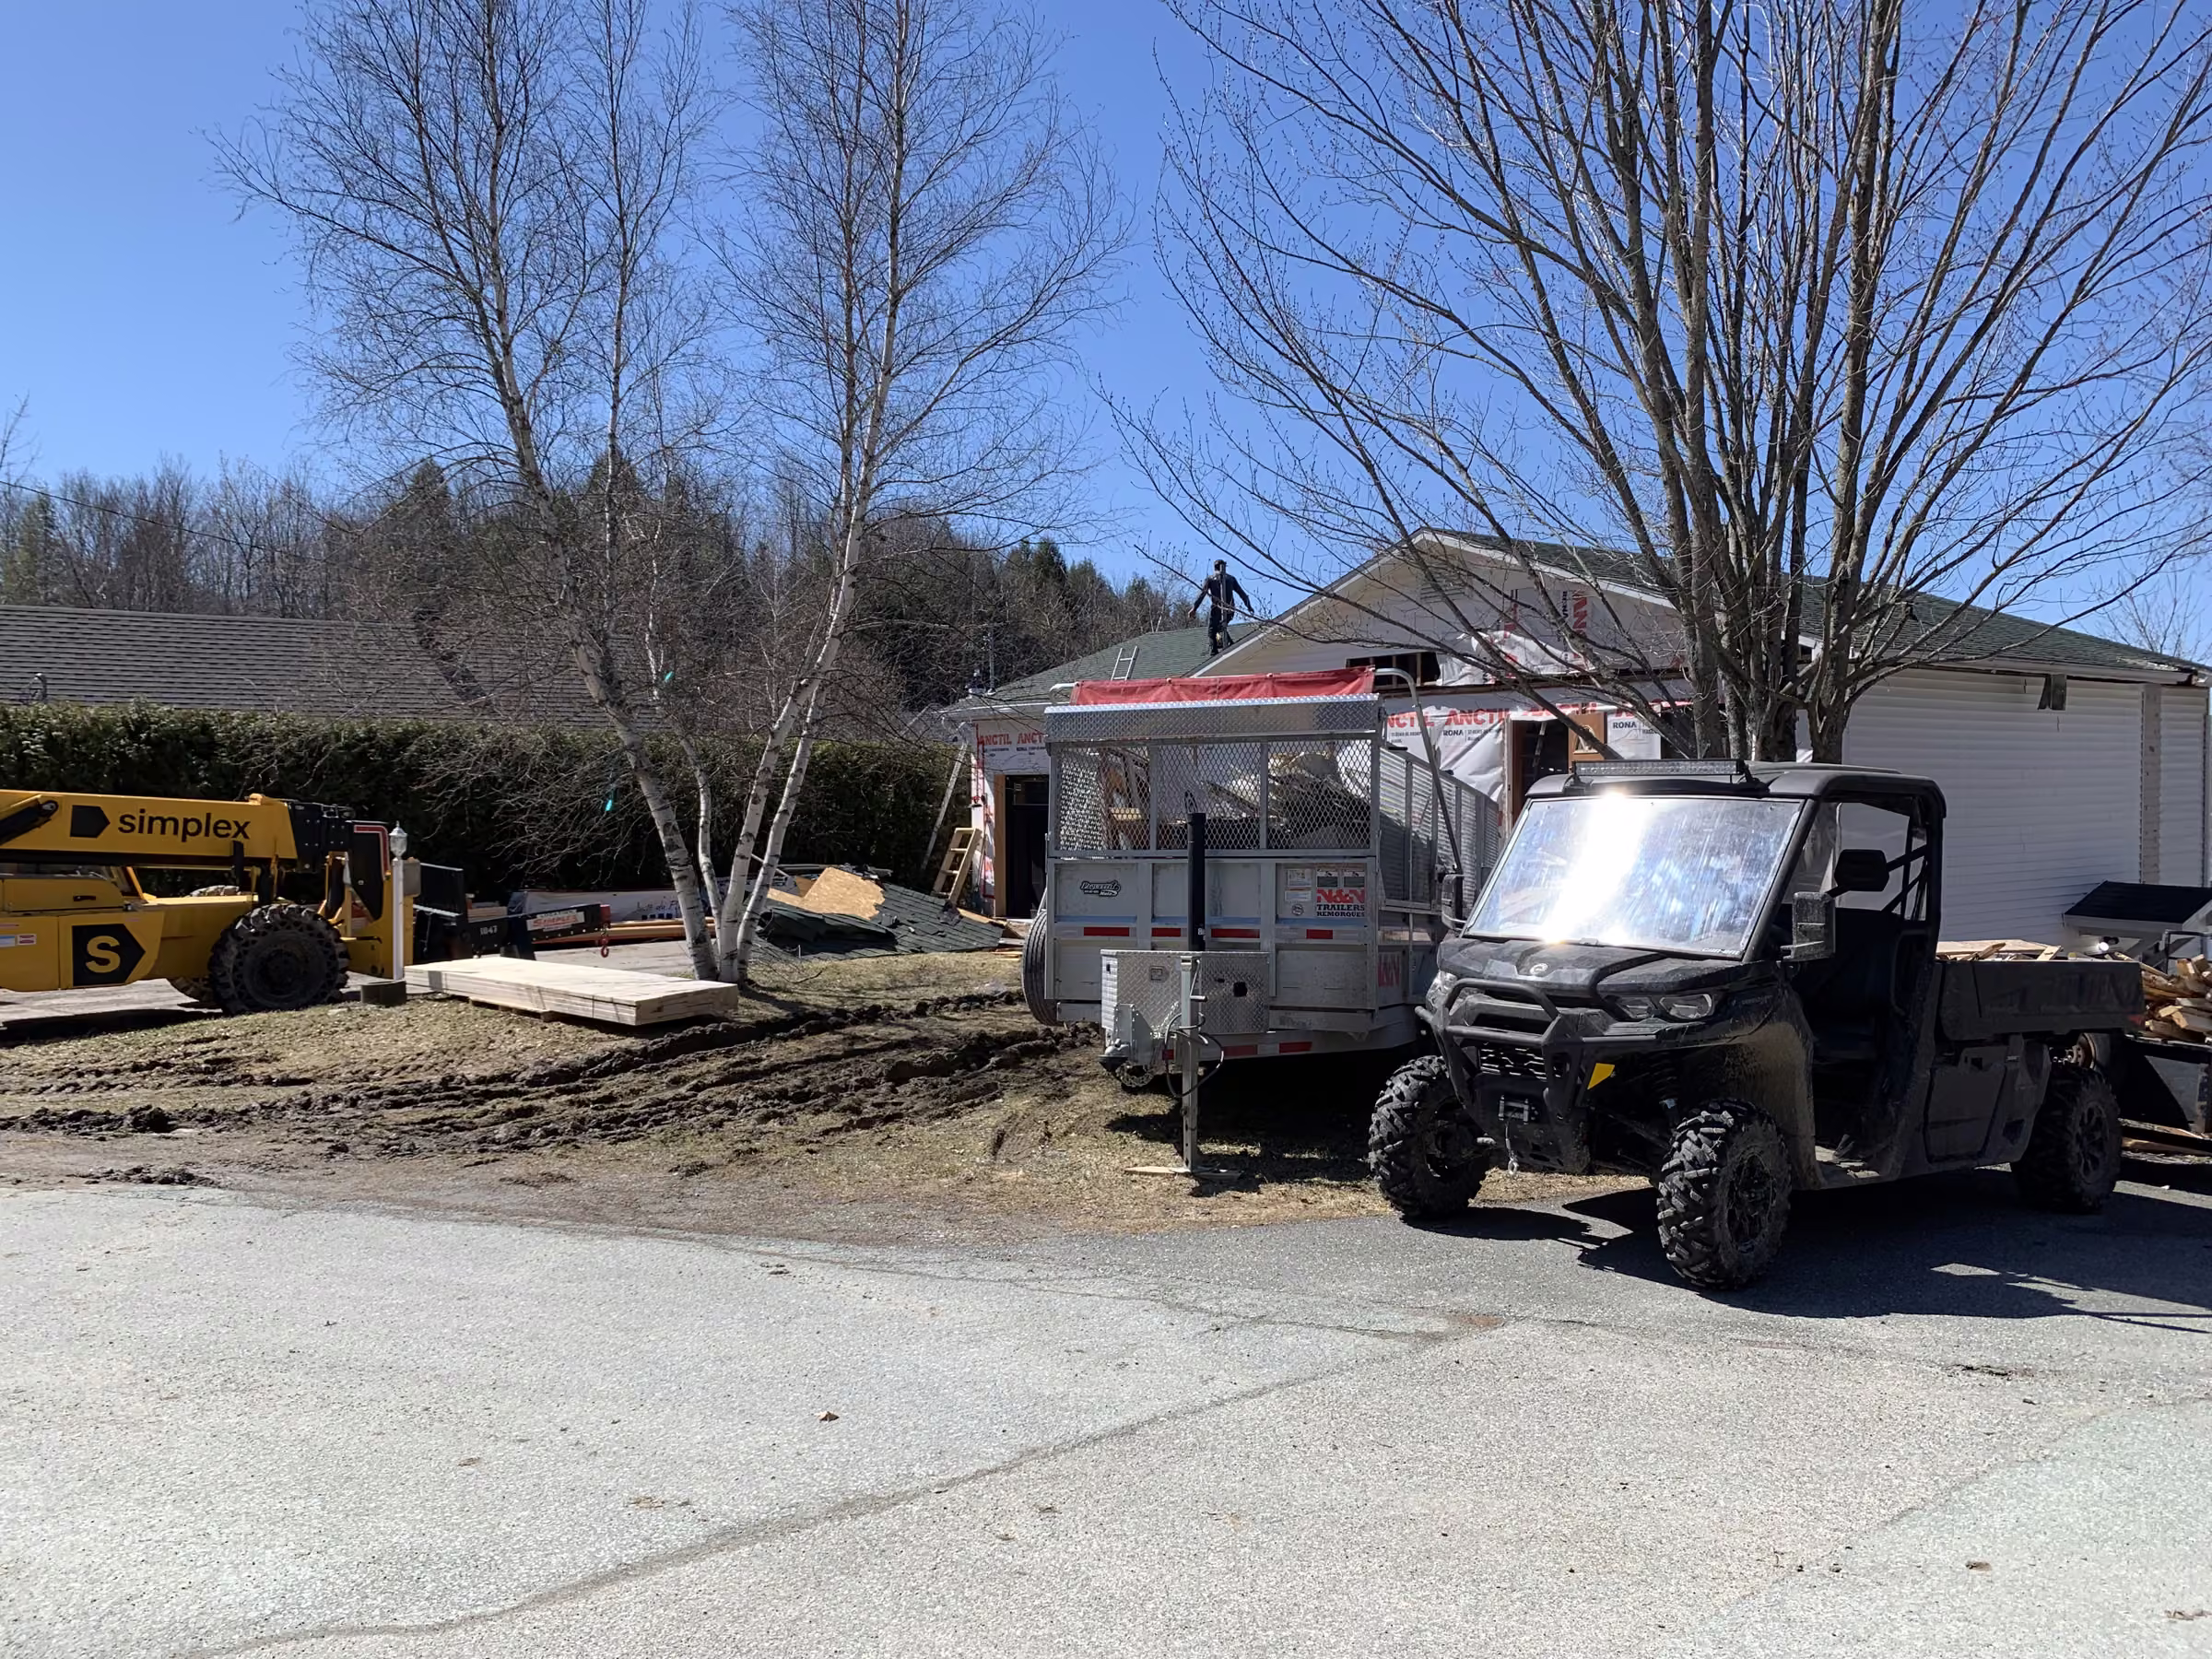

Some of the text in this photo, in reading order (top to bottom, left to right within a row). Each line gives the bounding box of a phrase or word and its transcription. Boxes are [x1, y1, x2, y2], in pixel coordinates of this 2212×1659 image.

[1612, 721, 1638, 729] RONA
[1018, 732, 1044, 744] ANCT
[118, 808, 251, 842] simplex
[1316, 903, 1365, 912] TRAILERS
[86, 935, 121, 973] S
